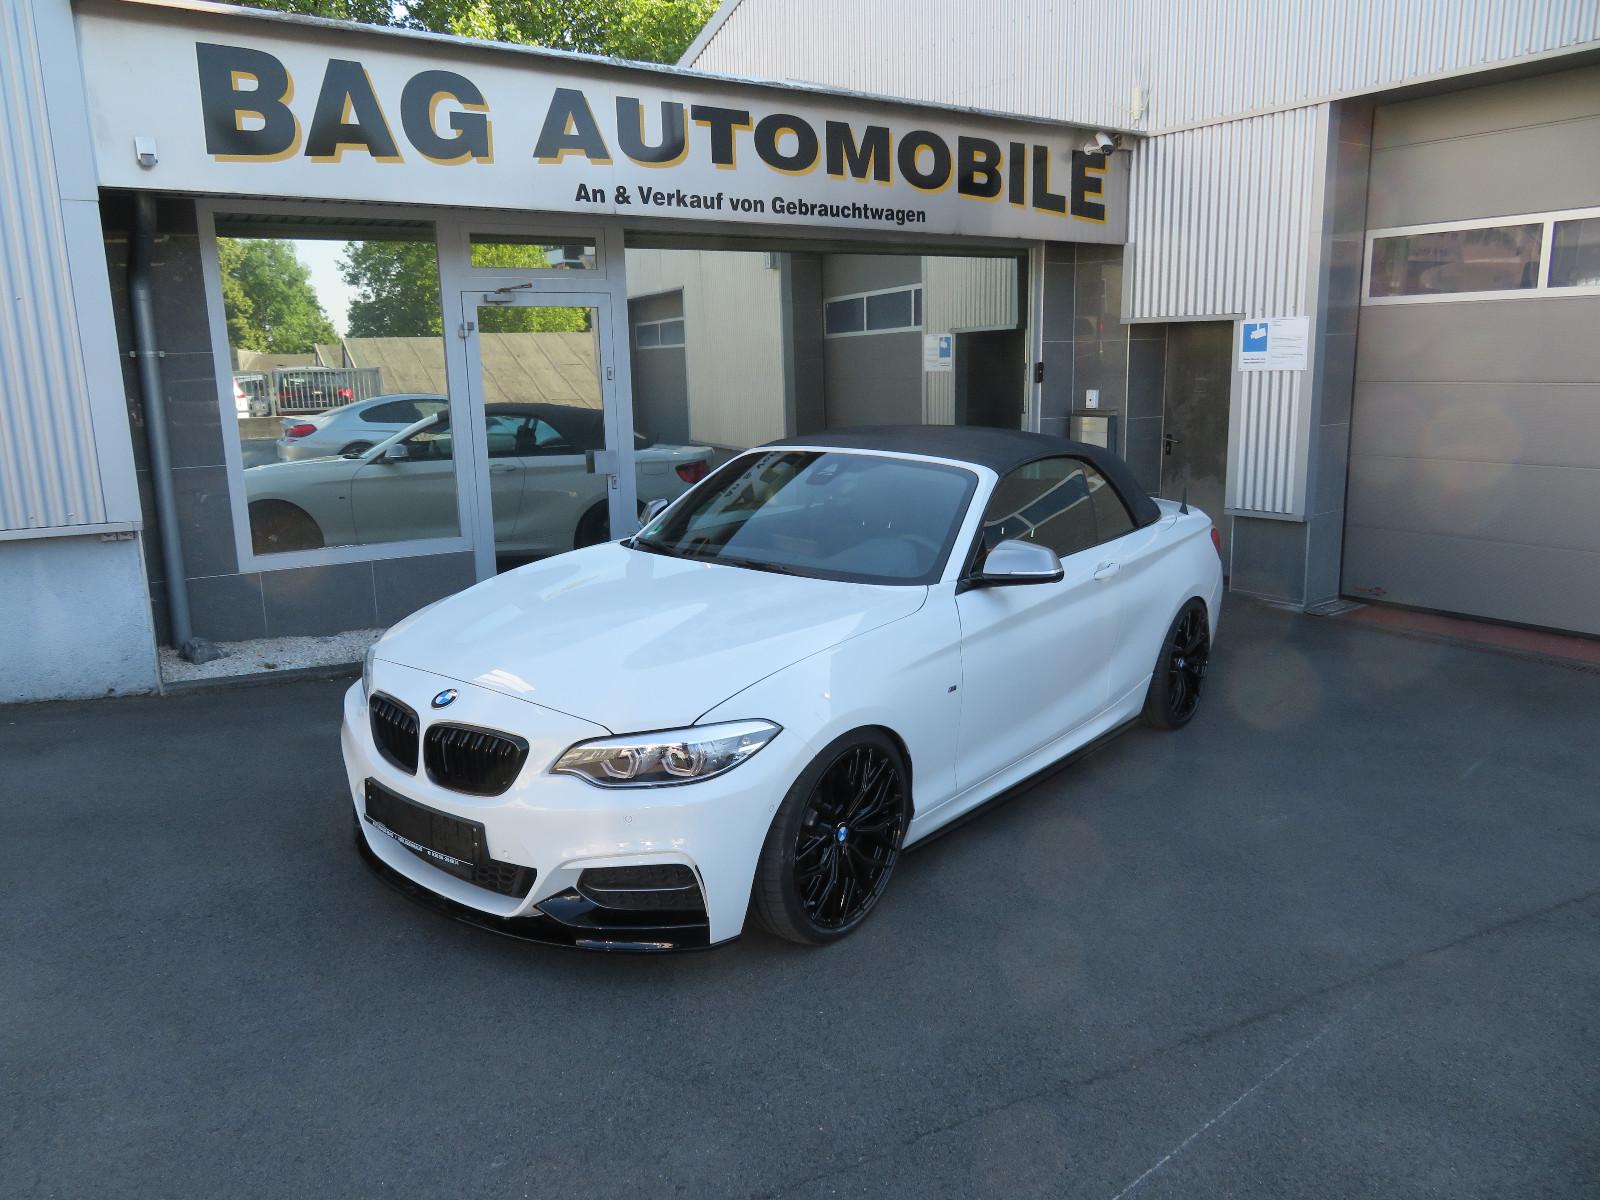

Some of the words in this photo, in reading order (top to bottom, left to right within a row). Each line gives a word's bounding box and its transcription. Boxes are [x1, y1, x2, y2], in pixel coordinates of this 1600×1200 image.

[195, 42, 494, 164] BAG
[533, 87, 1107, 224] AUTOMOBILE
[575, 183, 606, 203] An
[614, 185, 632, 205] &
[637, 185, 724, 210] Verkauf
[729, 197, 765, 213] von
[771, 196, 926, 225] Gebrauchtwagen
